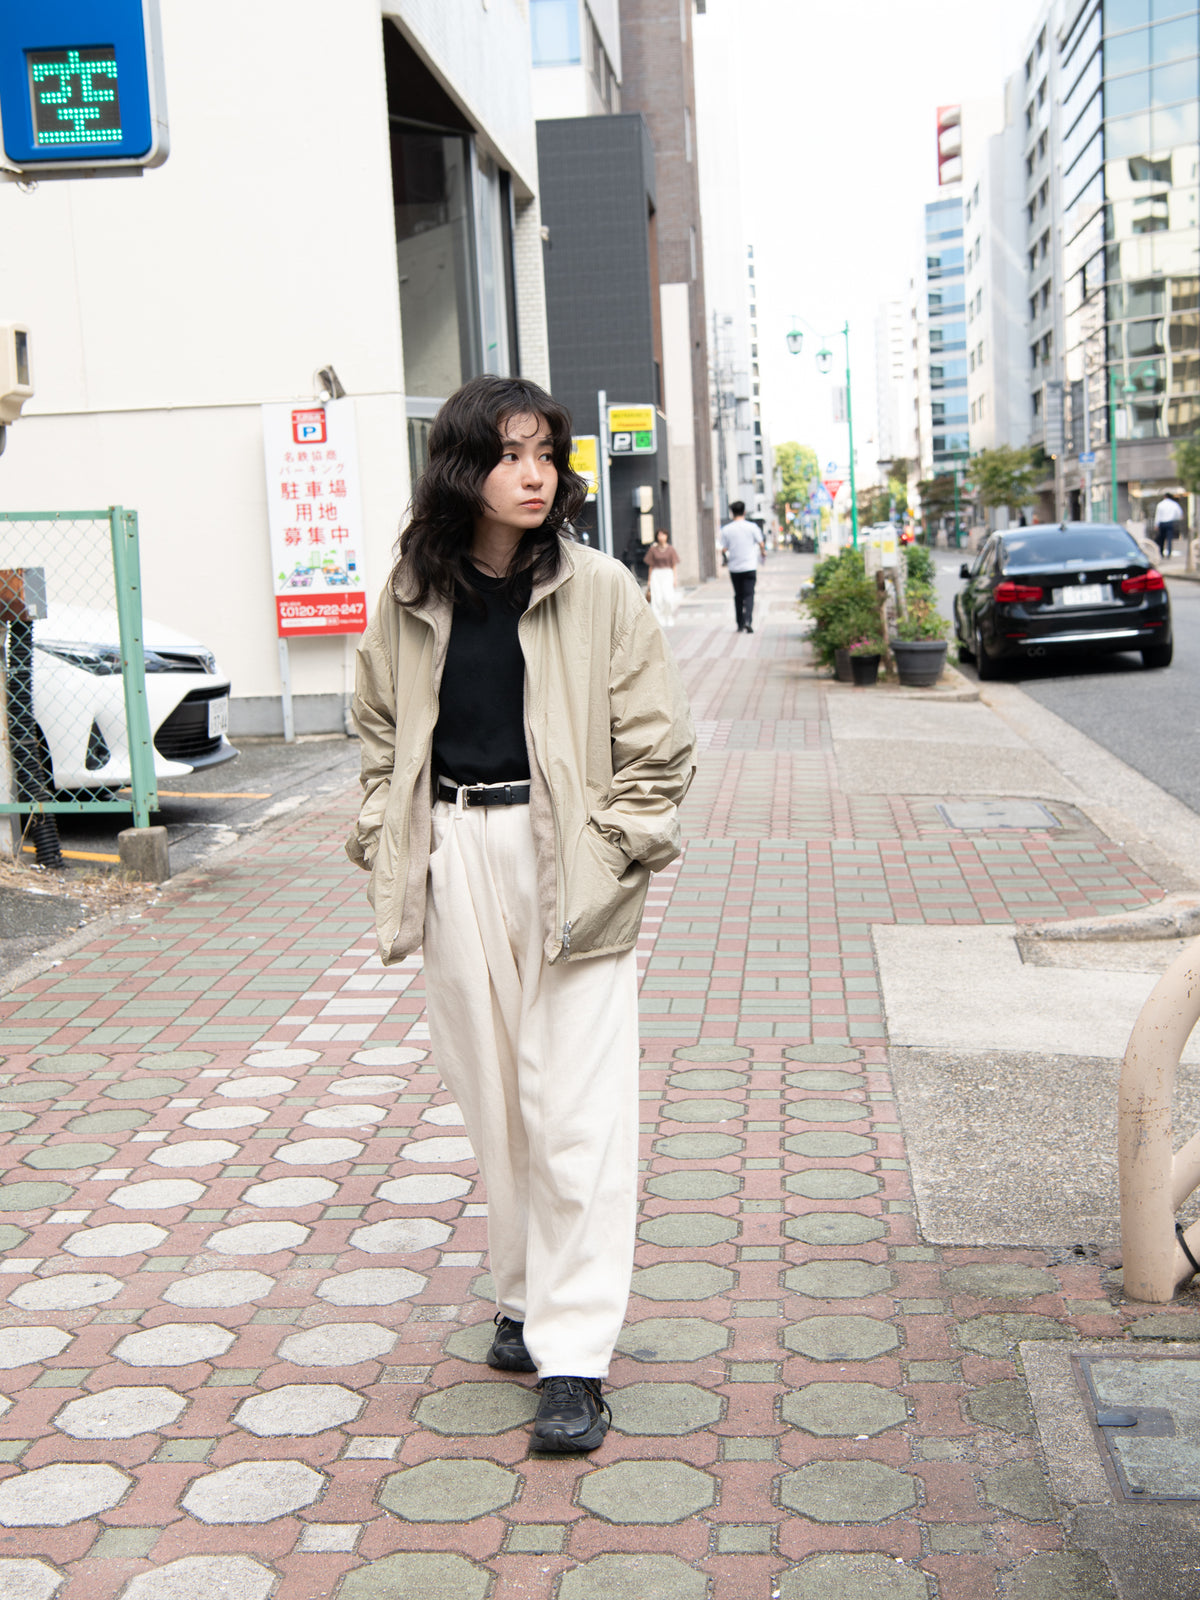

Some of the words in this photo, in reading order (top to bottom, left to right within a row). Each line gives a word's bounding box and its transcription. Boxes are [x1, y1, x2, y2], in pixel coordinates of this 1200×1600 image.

[32, 51, 123, 144] 空
[303, 426, 316, 438] P
[613, 433, 631, 451] P
[280, 463, 344, 475] パーキング
[281, 479, 347, 500] 駐車場
[296, 502, 338, 522] 用地
[284, 525, 349, 546] 募集中
